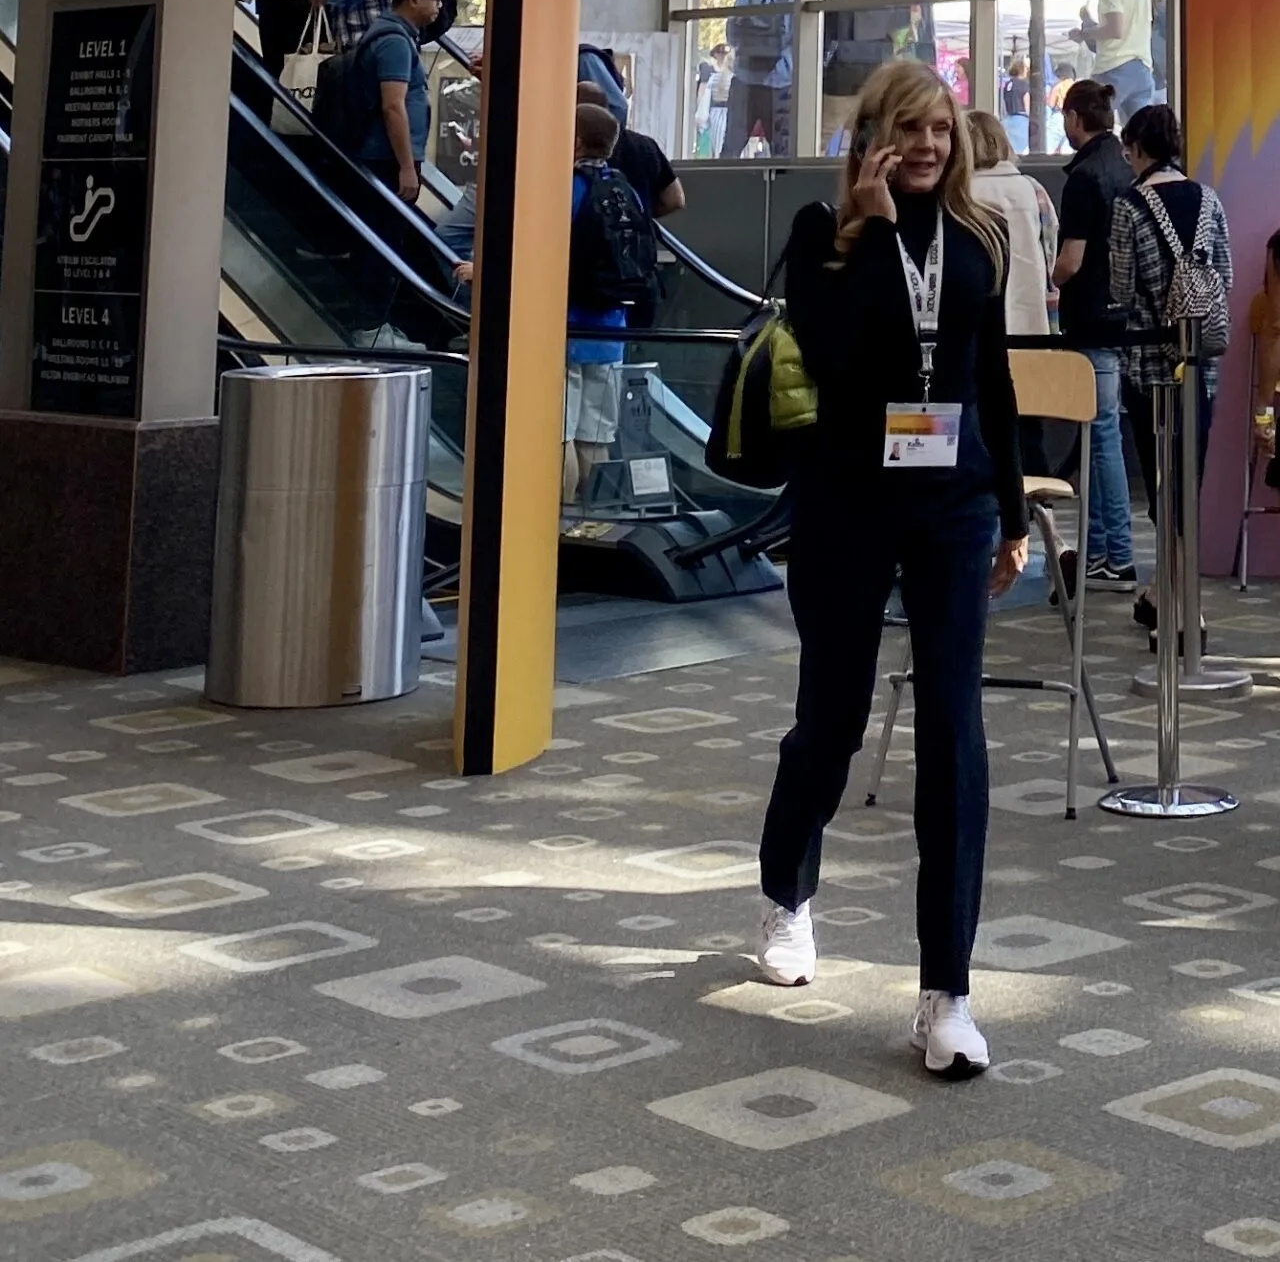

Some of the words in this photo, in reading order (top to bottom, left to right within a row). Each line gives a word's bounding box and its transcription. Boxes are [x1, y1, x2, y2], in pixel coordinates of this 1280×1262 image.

[79, 41, 115, 58] LEVEL
[119, 39, 127, 56] 1
[62, 307, 98, 325] LEVEL
[101, 308, 110, 325] 4
